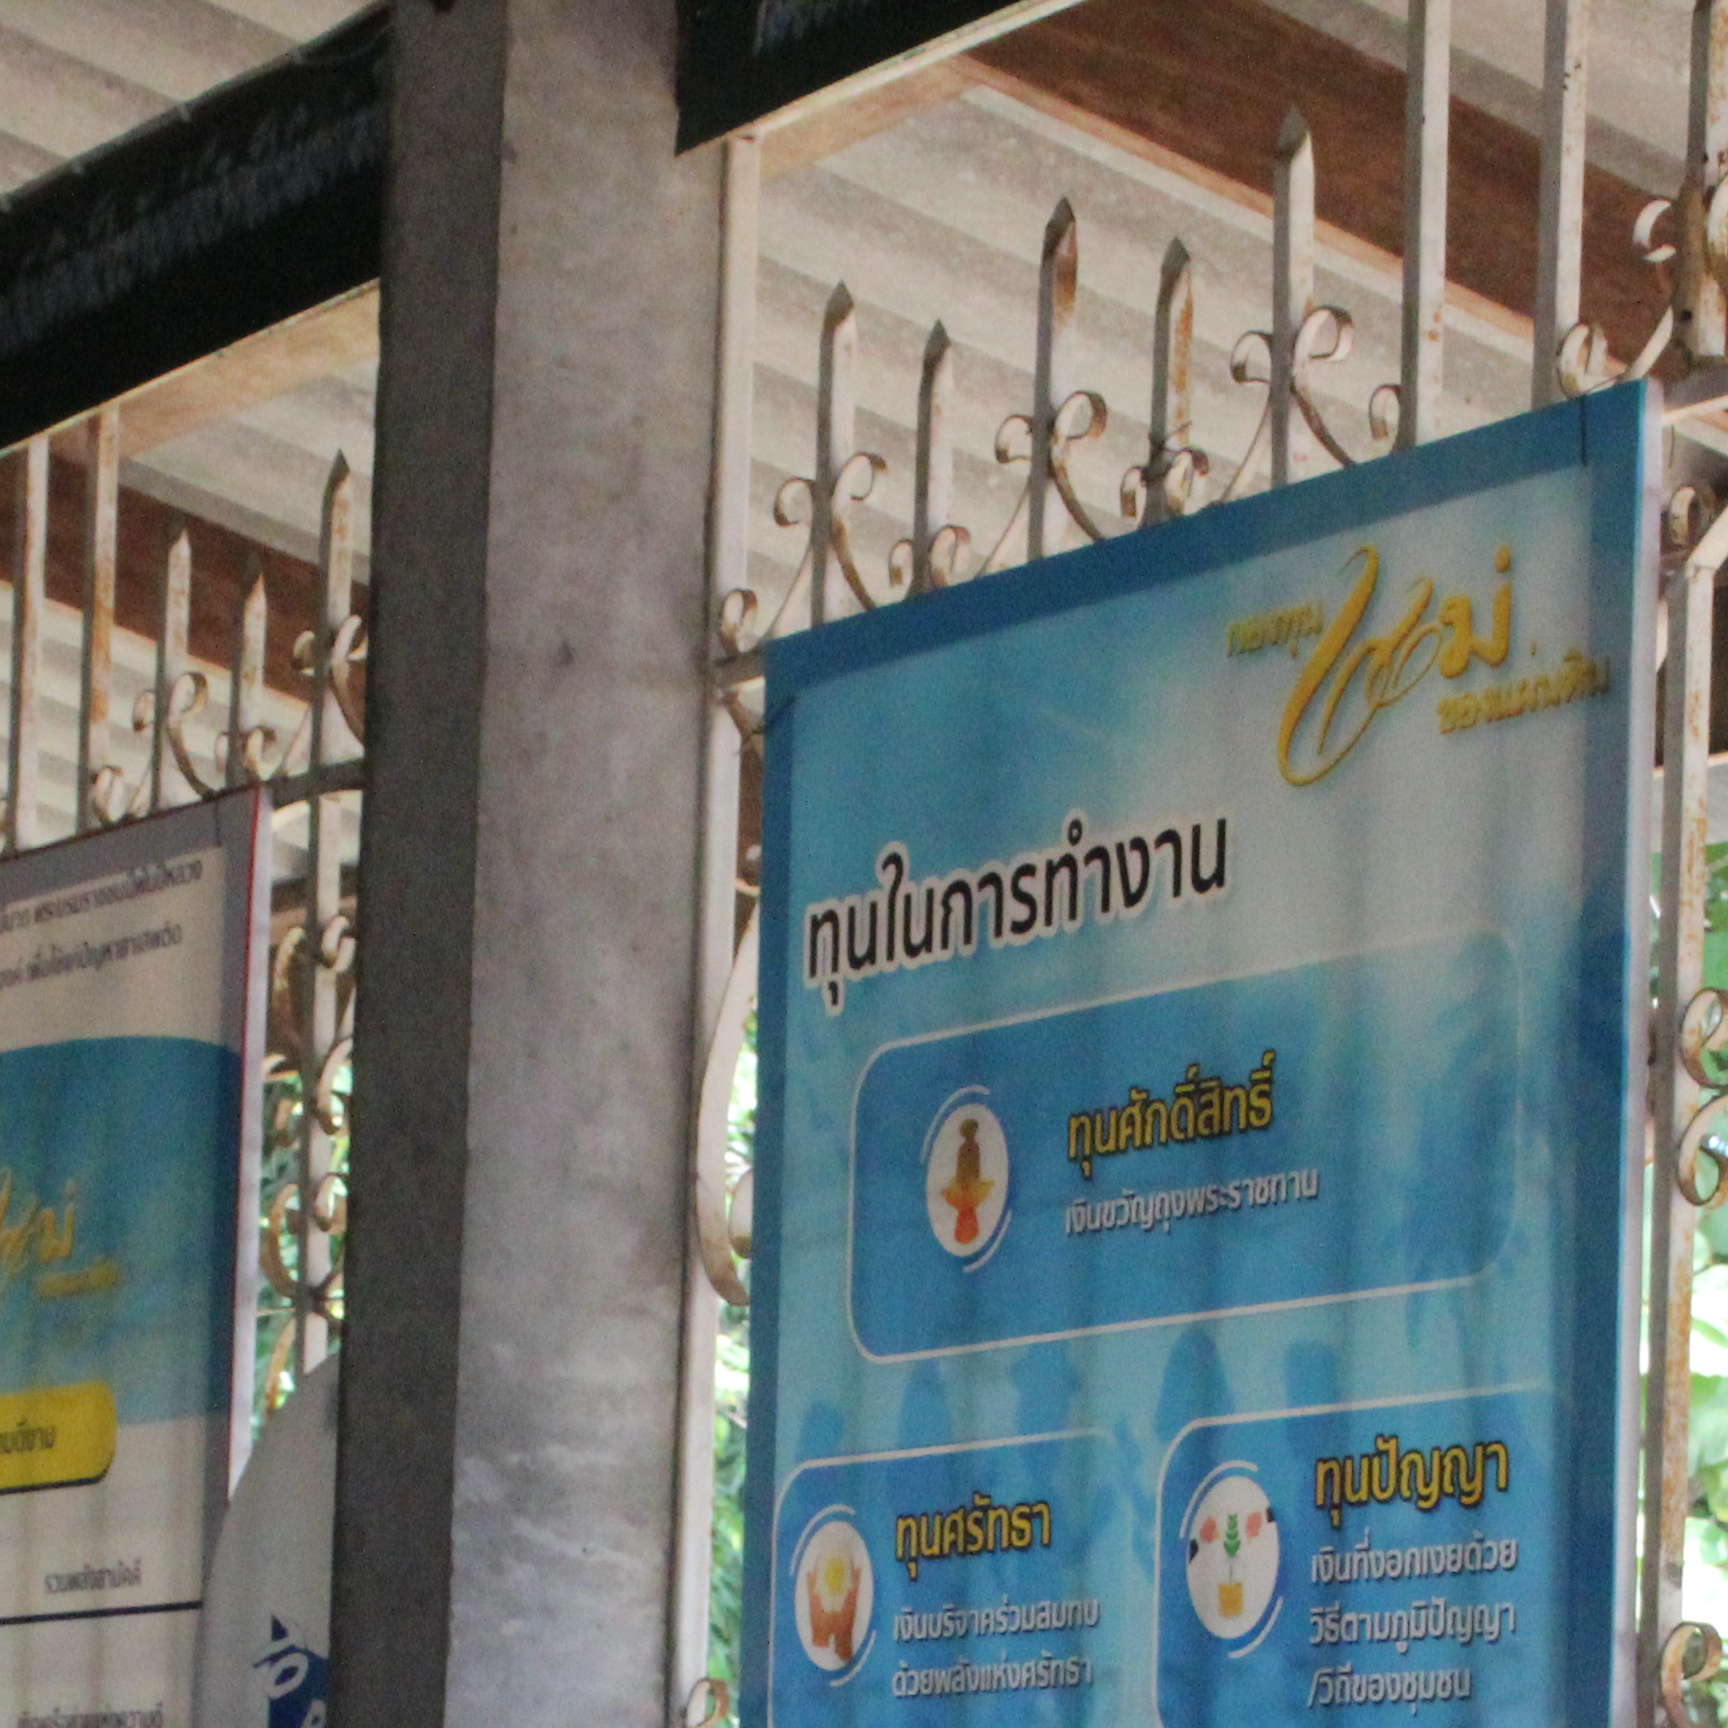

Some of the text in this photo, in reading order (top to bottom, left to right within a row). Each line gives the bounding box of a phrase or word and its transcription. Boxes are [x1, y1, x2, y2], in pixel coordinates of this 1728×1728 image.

[807, 816, 1228, 1006] ทุนในการทำงาน
[1068, 1048, 1275, 1179] ทุนศักดิ์สิทธิ์
[1065, 1168, 1320, 1234] เงินขวัญถุงพระราชทาน
[1315, 1434, 1509, 1529] ทุนปัญญา
[895, 1491, 1052, 1583] ทุนศรัทธา
[1312, 1526, 1518, 1584] เงินที่งอกเงยด้วย
[894, 1594, 1100, 1643] เงินบริจาคร่วมสมทบ
[892, 1650, 1093, 1698] ด้วยพลังแห่งศรัทธา
